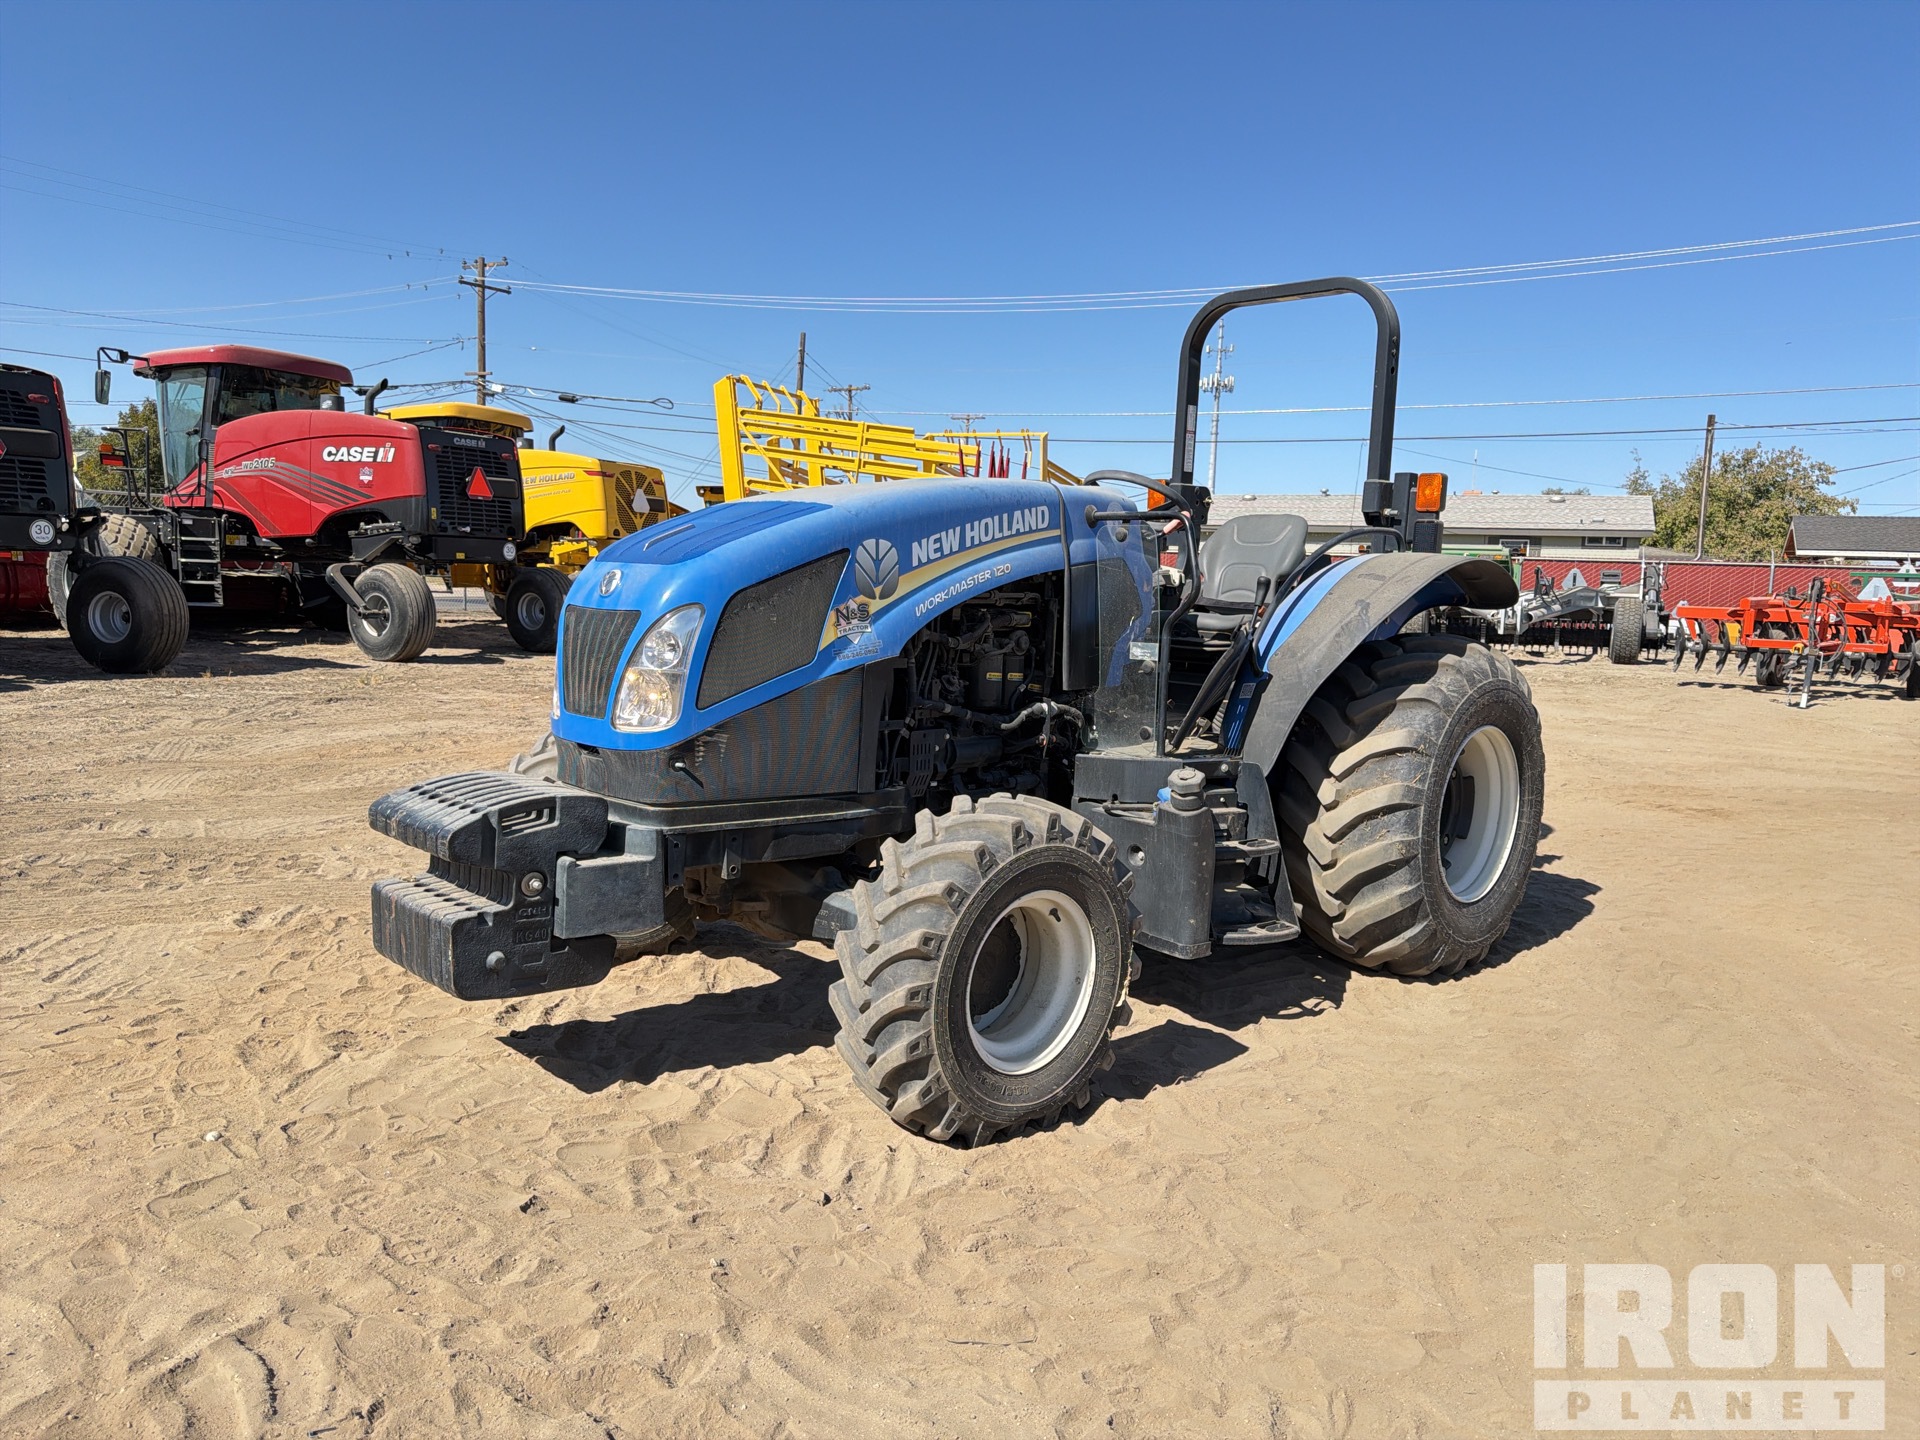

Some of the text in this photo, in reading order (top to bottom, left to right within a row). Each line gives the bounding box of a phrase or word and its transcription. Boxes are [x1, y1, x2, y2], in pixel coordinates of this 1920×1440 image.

[453, 437, 478, 447] CASE
[322, 446, 376, 462] CASE
[242, 457, 276, 470] WD2105
[538, 472, 576, 483] HOLLAND
[35, 524, 51, 535] 30
[911, 505, 1050, 567] NEW HOLLAND
[915, 563, 1012, 617] WORKMASTER 120
[834, 603, 870, 627] N&S
[839, 624, 869, 635] TRACTOR
